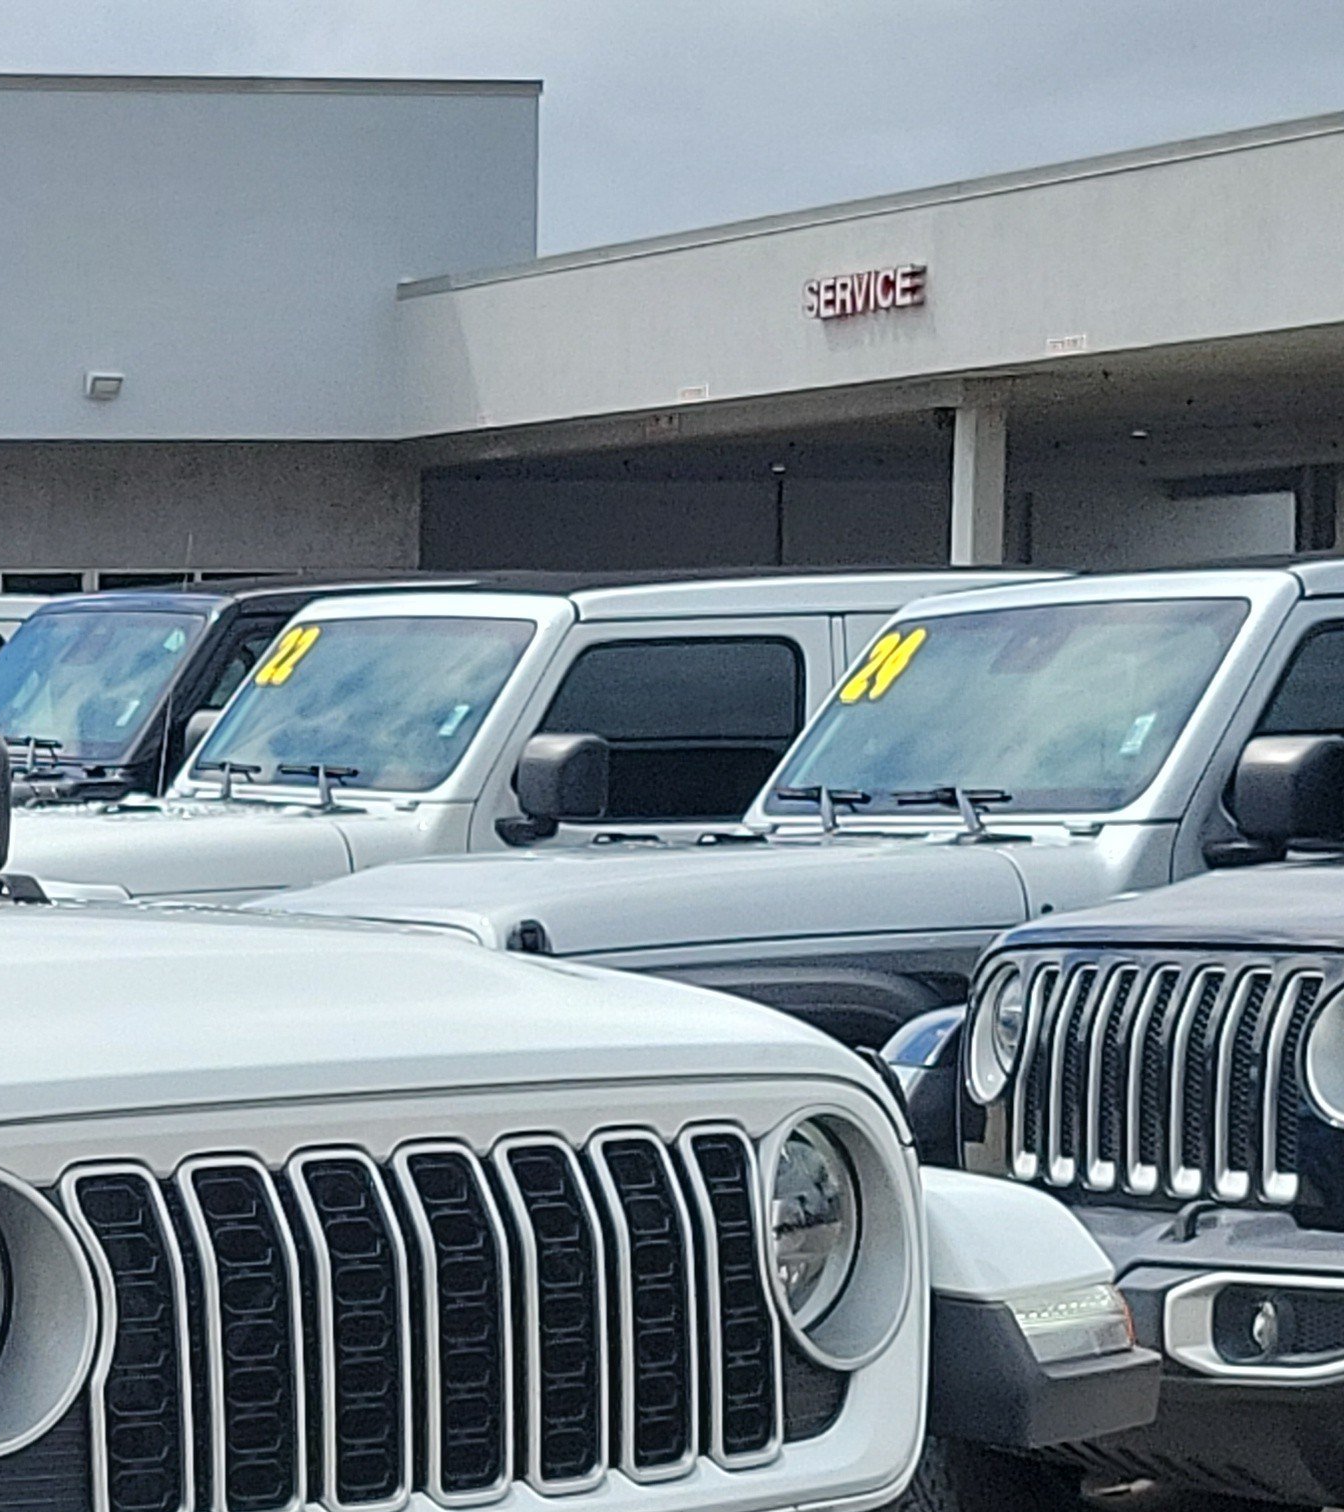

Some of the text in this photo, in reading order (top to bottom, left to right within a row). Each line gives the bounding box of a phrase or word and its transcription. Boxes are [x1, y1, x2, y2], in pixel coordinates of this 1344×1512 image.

[802, 264, 925, 319] SERVICE
[255, 626, 320, 687] 22
[839, 627, 927, 703] 24
